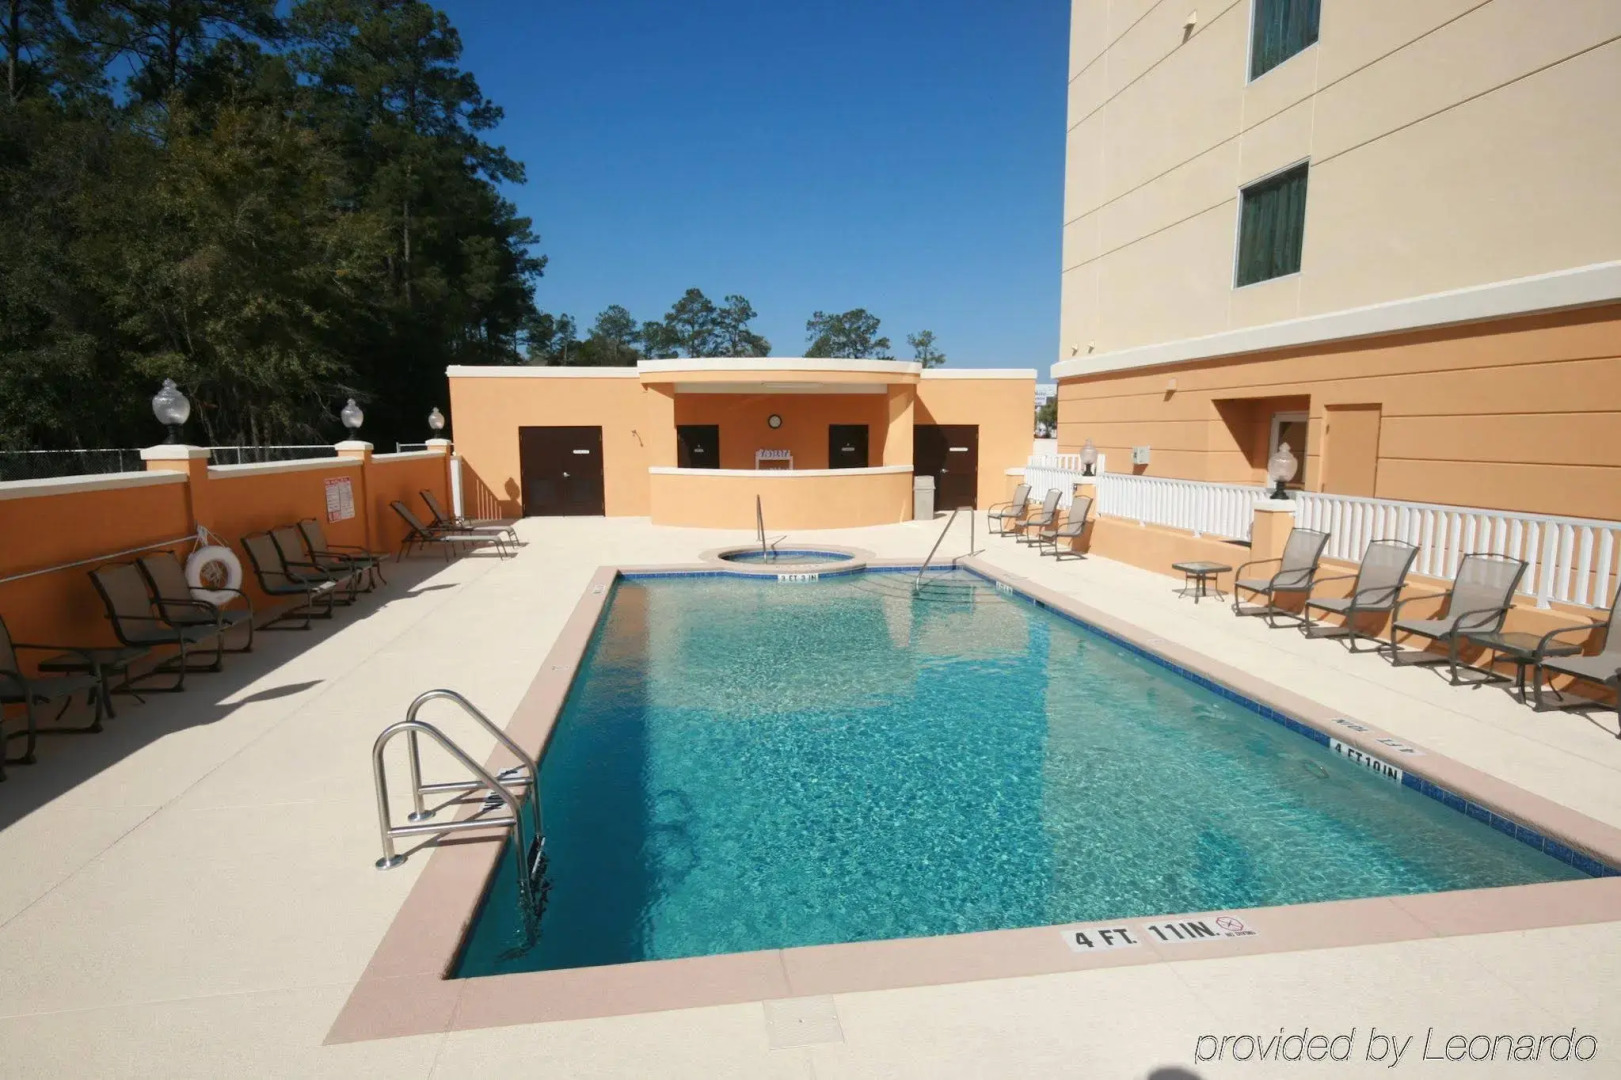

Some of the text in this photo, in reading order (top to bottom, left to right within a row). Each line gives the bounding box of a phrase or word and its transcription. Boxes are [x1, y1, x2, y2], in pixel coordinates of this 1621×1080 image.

[1335, 743, 1341, 754] 4
[1347, 748, 1363, 763] FT
[1075, 932, 1095, 948] 4
[1098, 928, 1138, 946] FT.
